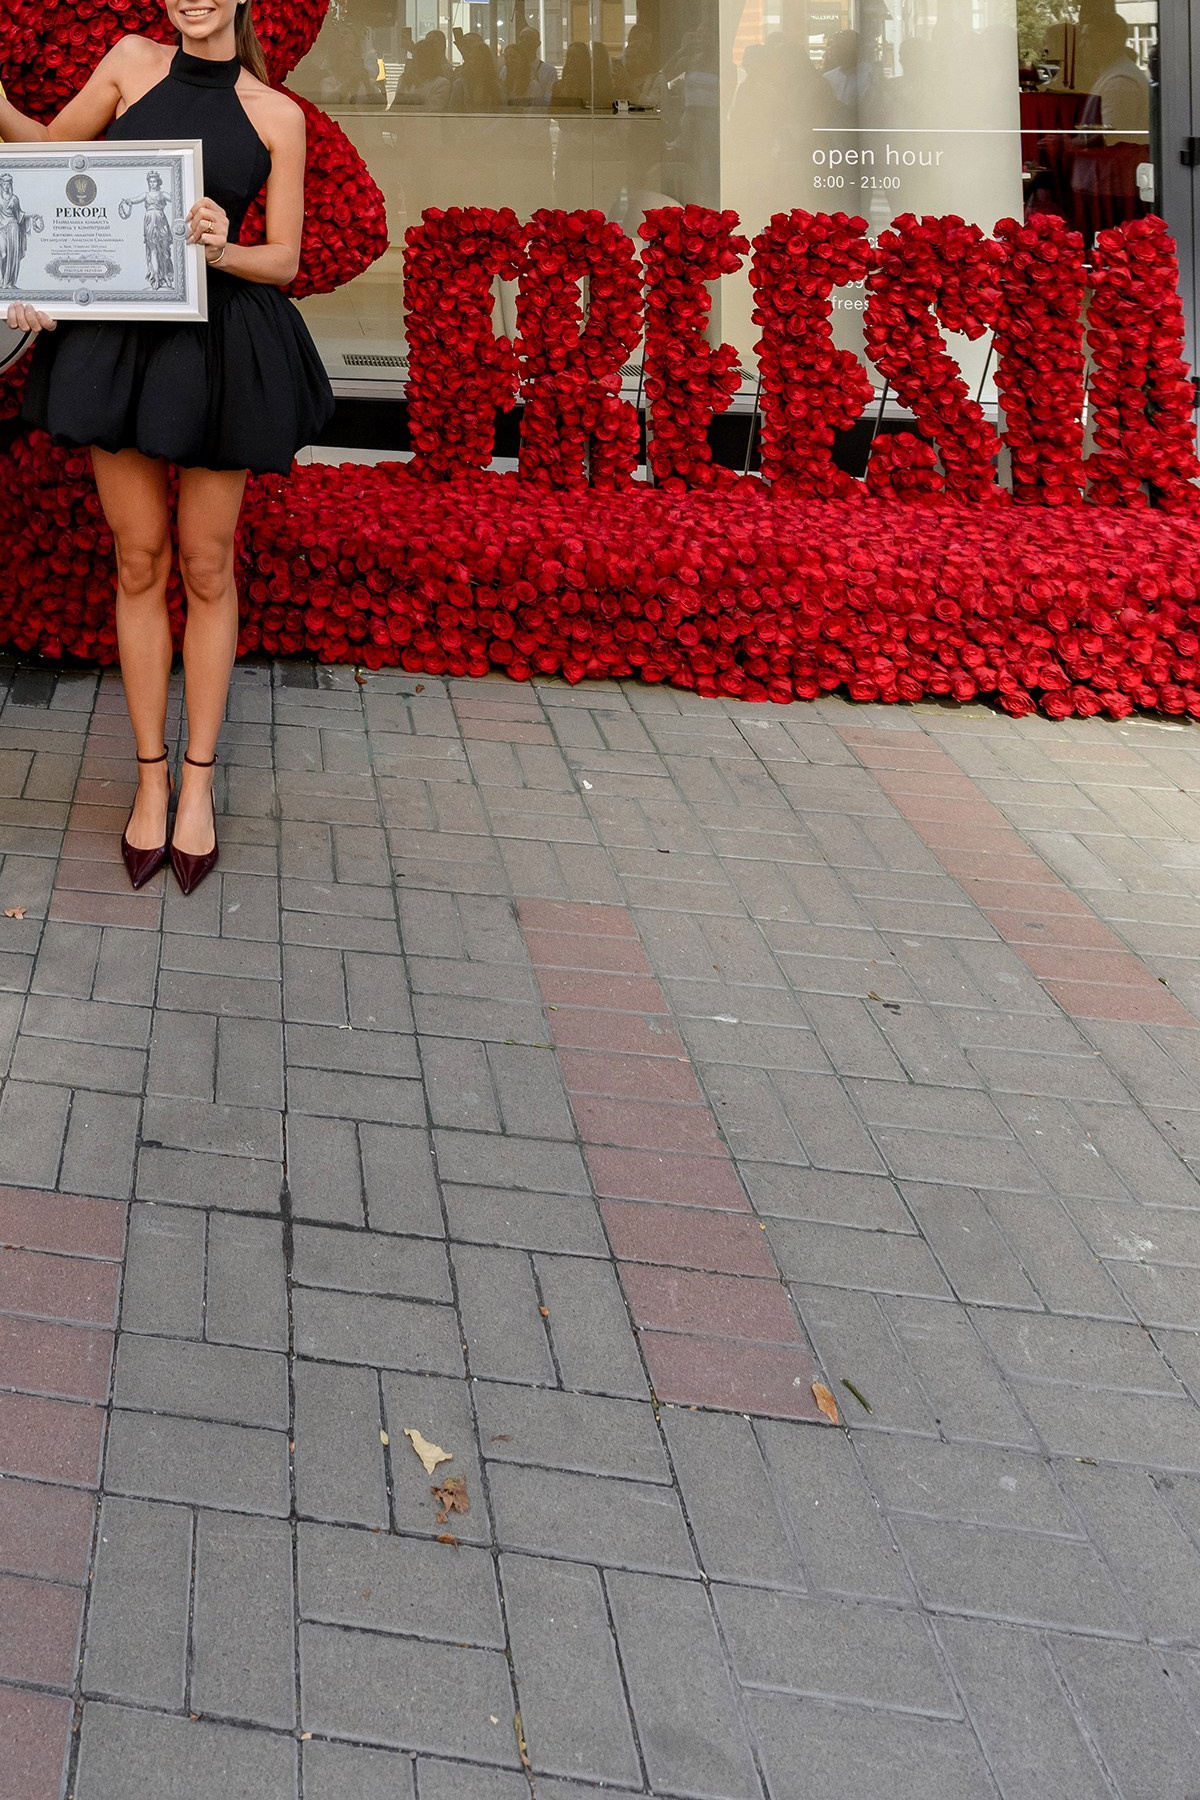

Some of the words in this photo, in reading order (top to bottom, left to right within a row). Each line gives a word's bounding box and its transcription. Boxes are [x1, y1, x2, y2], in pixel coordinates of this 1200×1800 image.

[812, 149, 875, 169] open
[886, 144, 945, 166] hour
[813, 175, 845, 189] 8:00
[860, 176, 901, 190] 21:00
[56, 207, 108, 219] РЕКОРД
